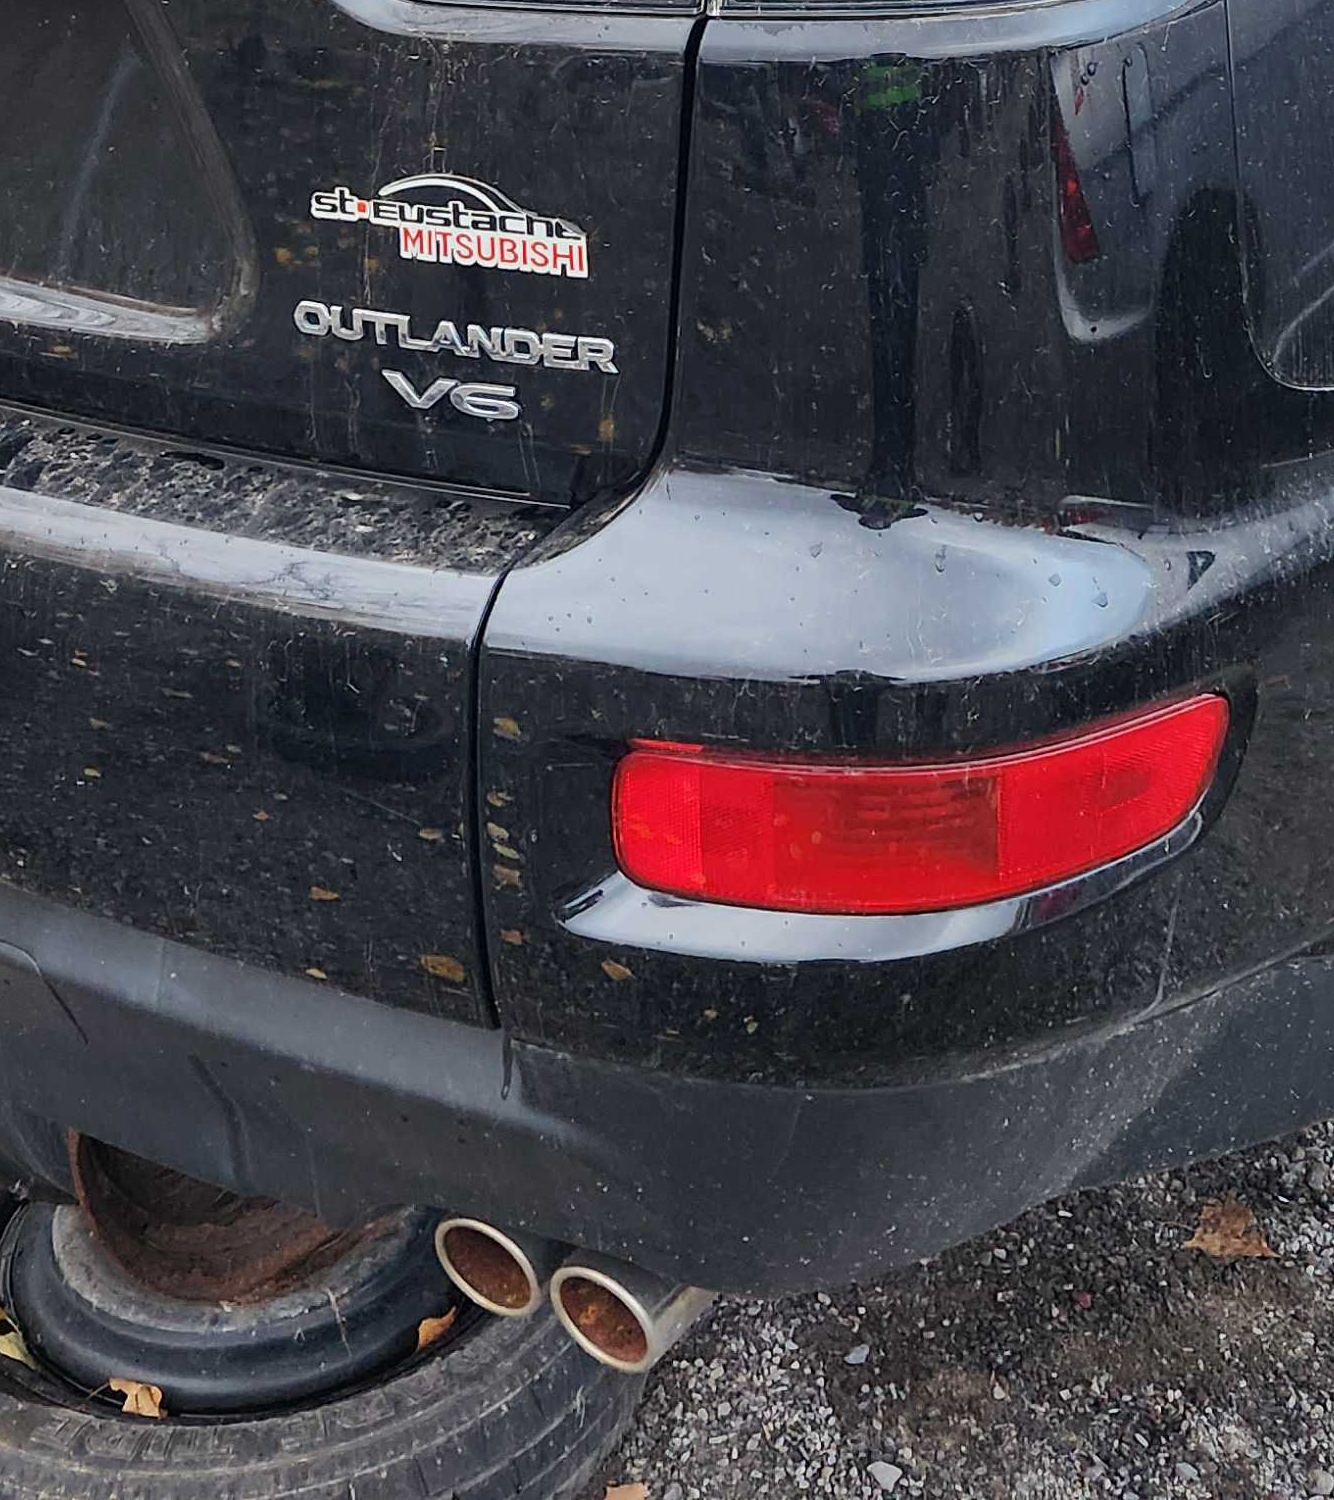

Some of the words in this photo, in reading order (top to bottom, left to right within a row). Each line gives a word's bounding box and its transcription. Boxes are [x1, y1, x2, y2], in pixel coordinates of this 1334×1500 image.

[402, 226, 585, 272] MITSUBISHI
[292, 299, 620, 375] OUTLANDER
[381, 368, 522, 422] V6
